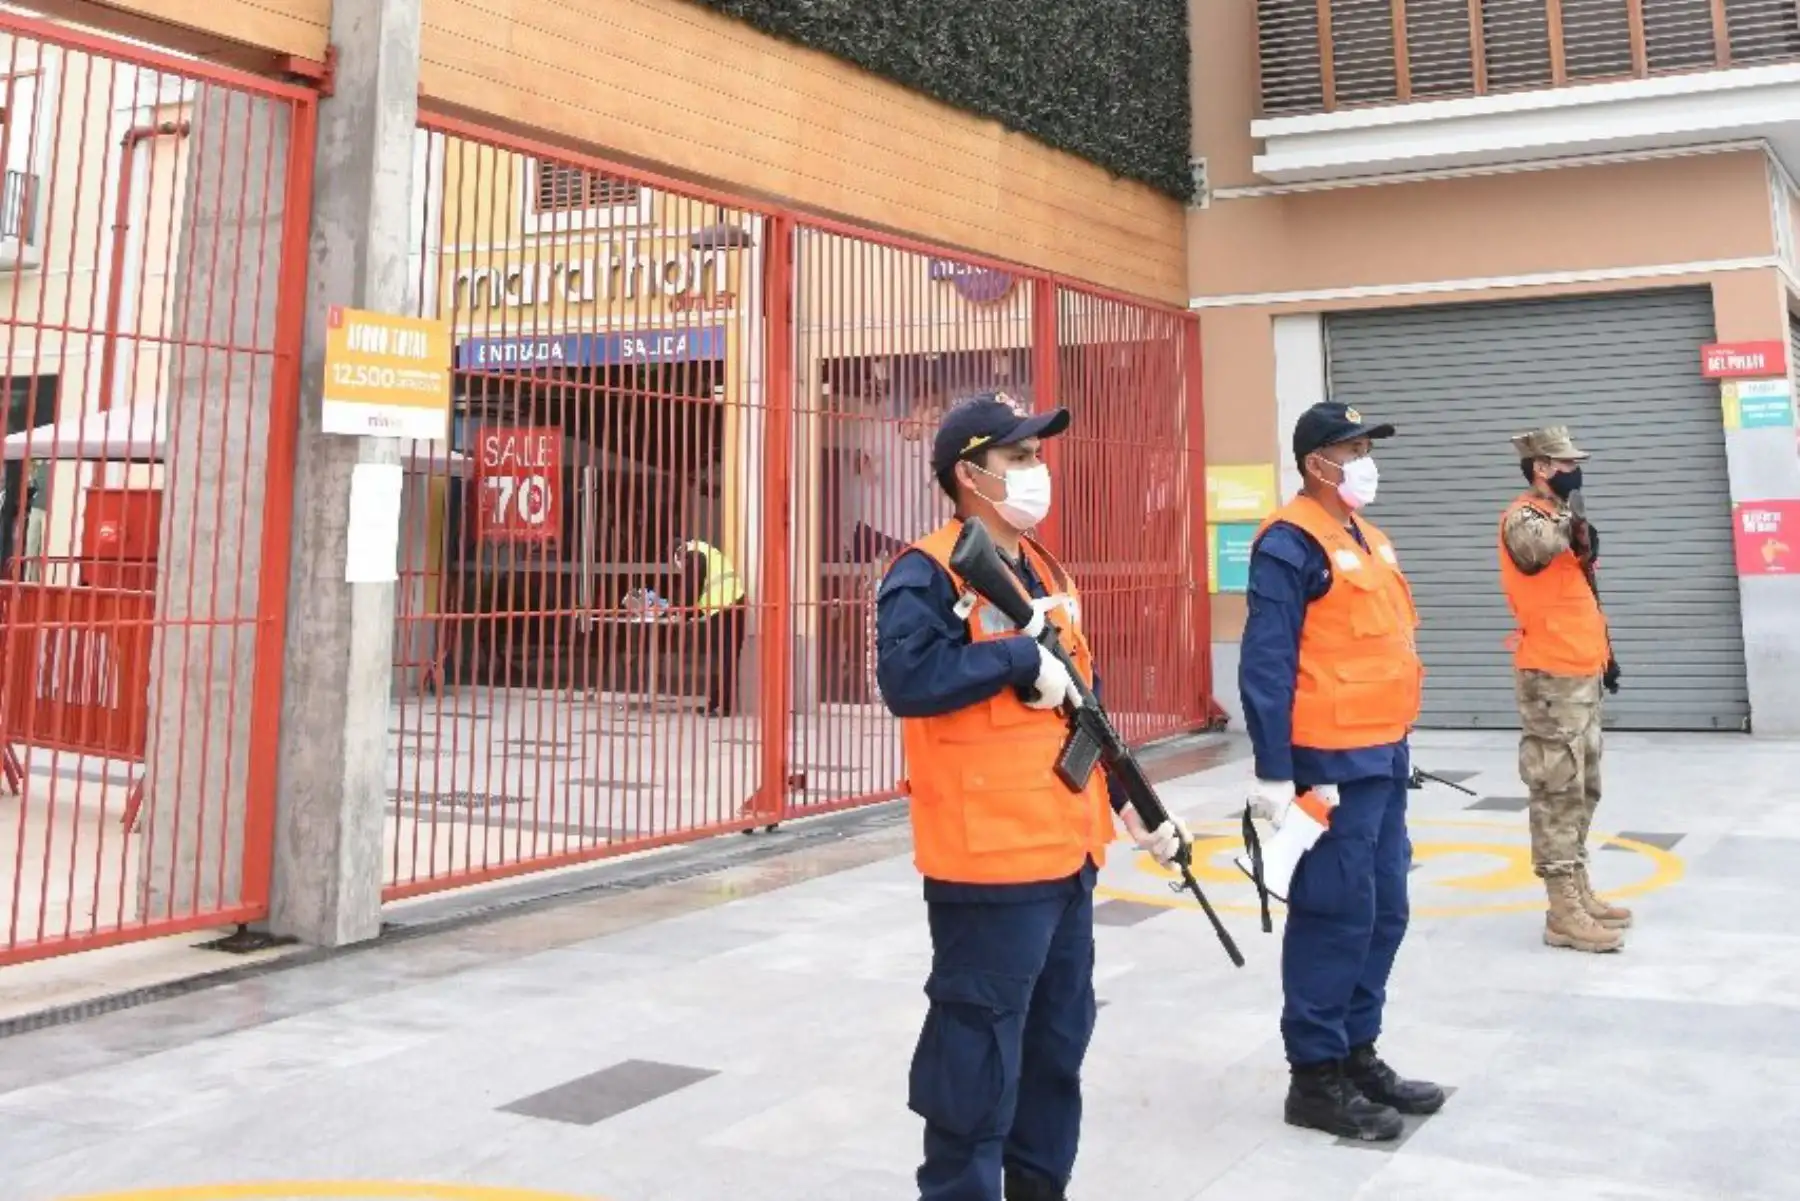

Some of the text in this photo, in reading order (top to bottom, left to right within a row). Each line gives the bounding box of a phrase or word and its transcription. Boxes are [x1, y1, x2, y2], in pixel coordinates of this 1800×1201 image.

[448, 238, 727, 309] marathon
[479, 335, 688, 362] ENTRADA SALIDA
[484, 436, 554, 467] SALE
[485, 474, 553, 524] 70
